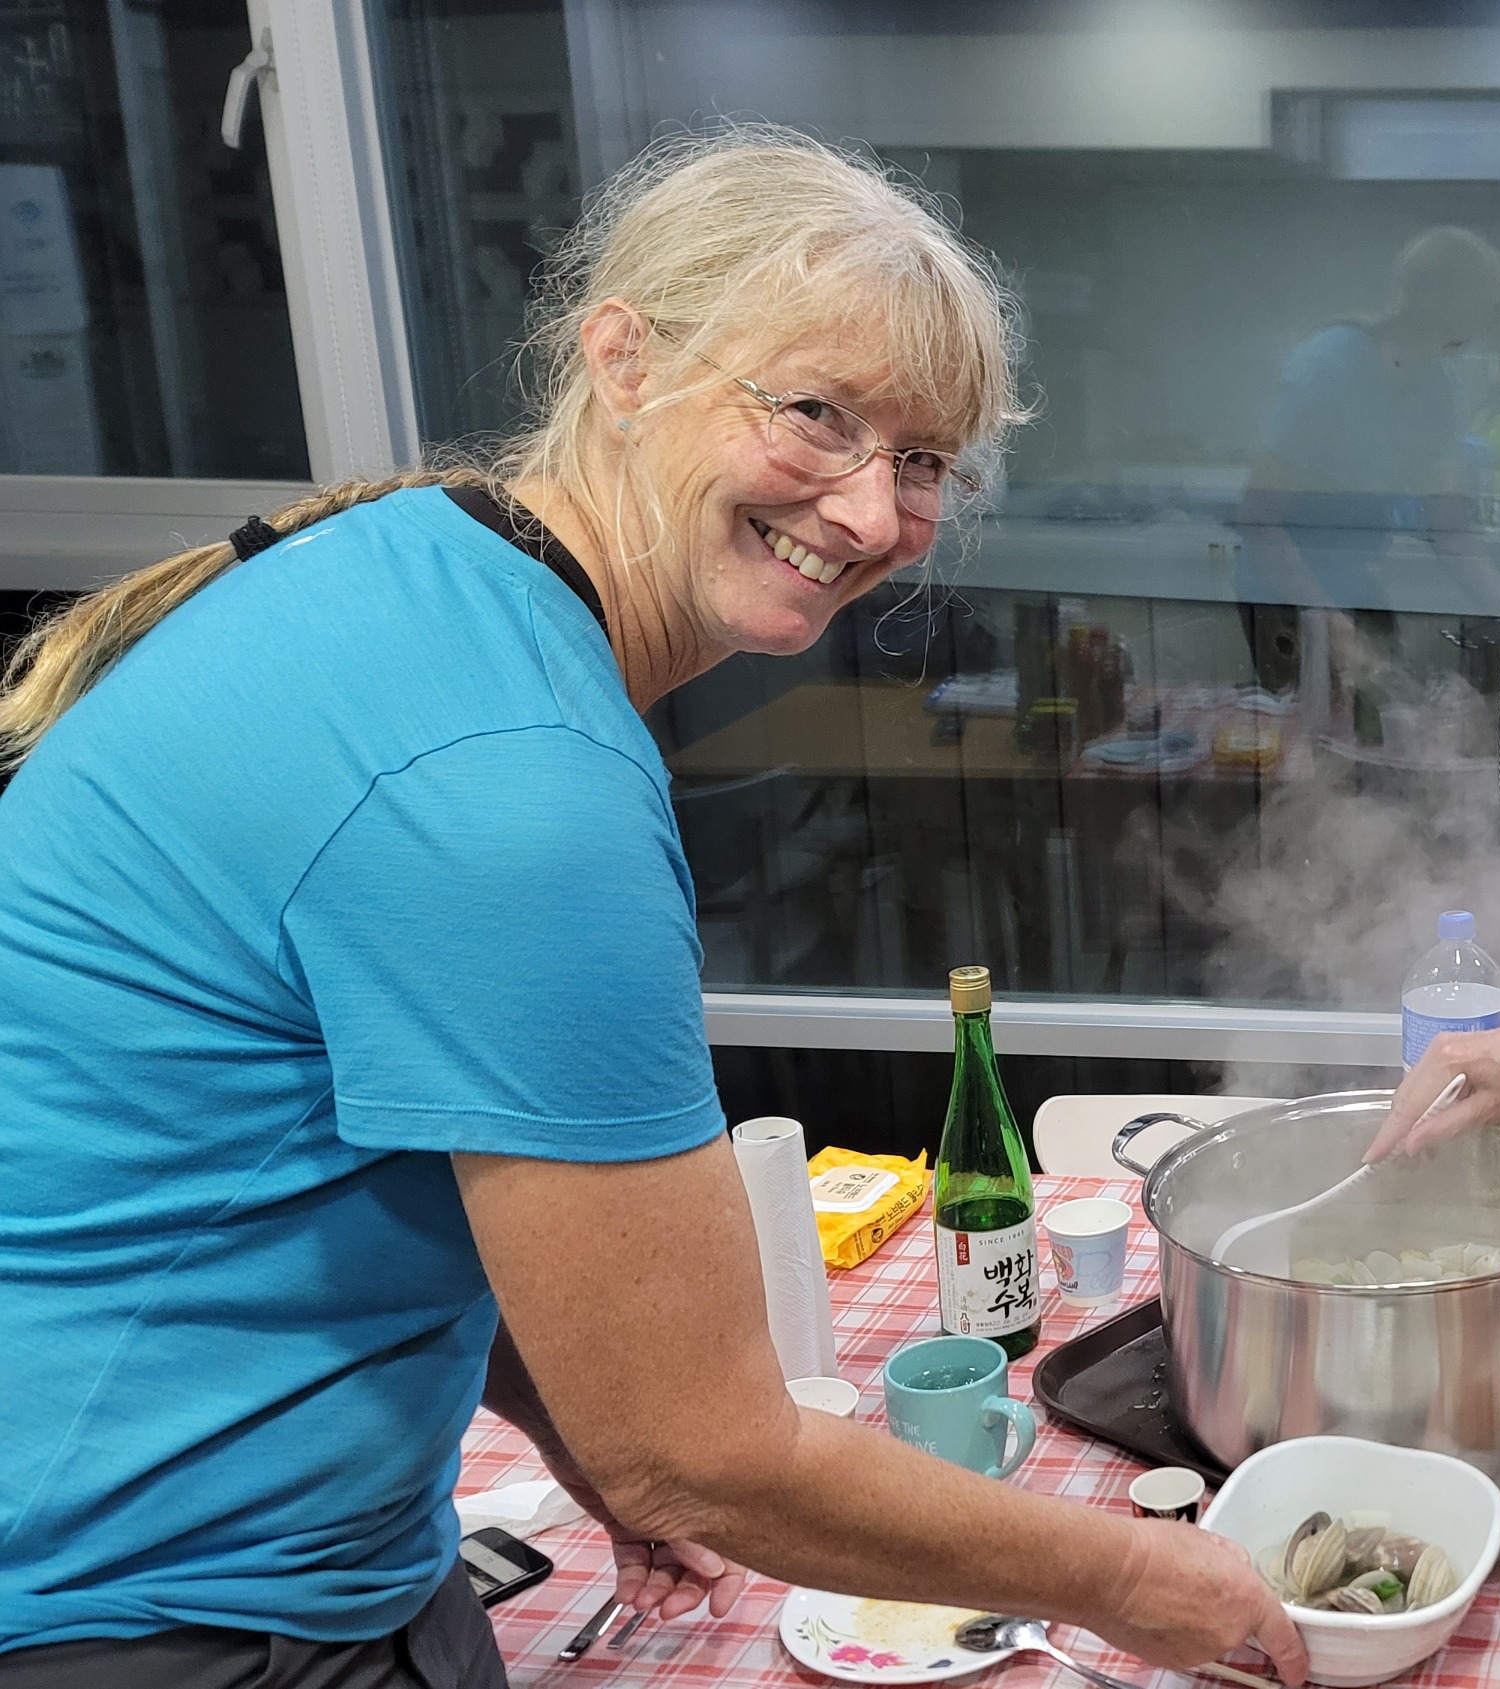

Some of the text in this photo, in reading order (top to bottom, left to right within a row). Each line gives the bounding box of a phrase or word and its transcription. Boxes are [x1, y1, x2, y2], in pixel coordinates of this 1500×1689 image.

[979, 1237, 1005, 1246] SINCE
[983, 1248, 1034, 1287] 백화
[987, 1278, 1035, 1318] 수복
